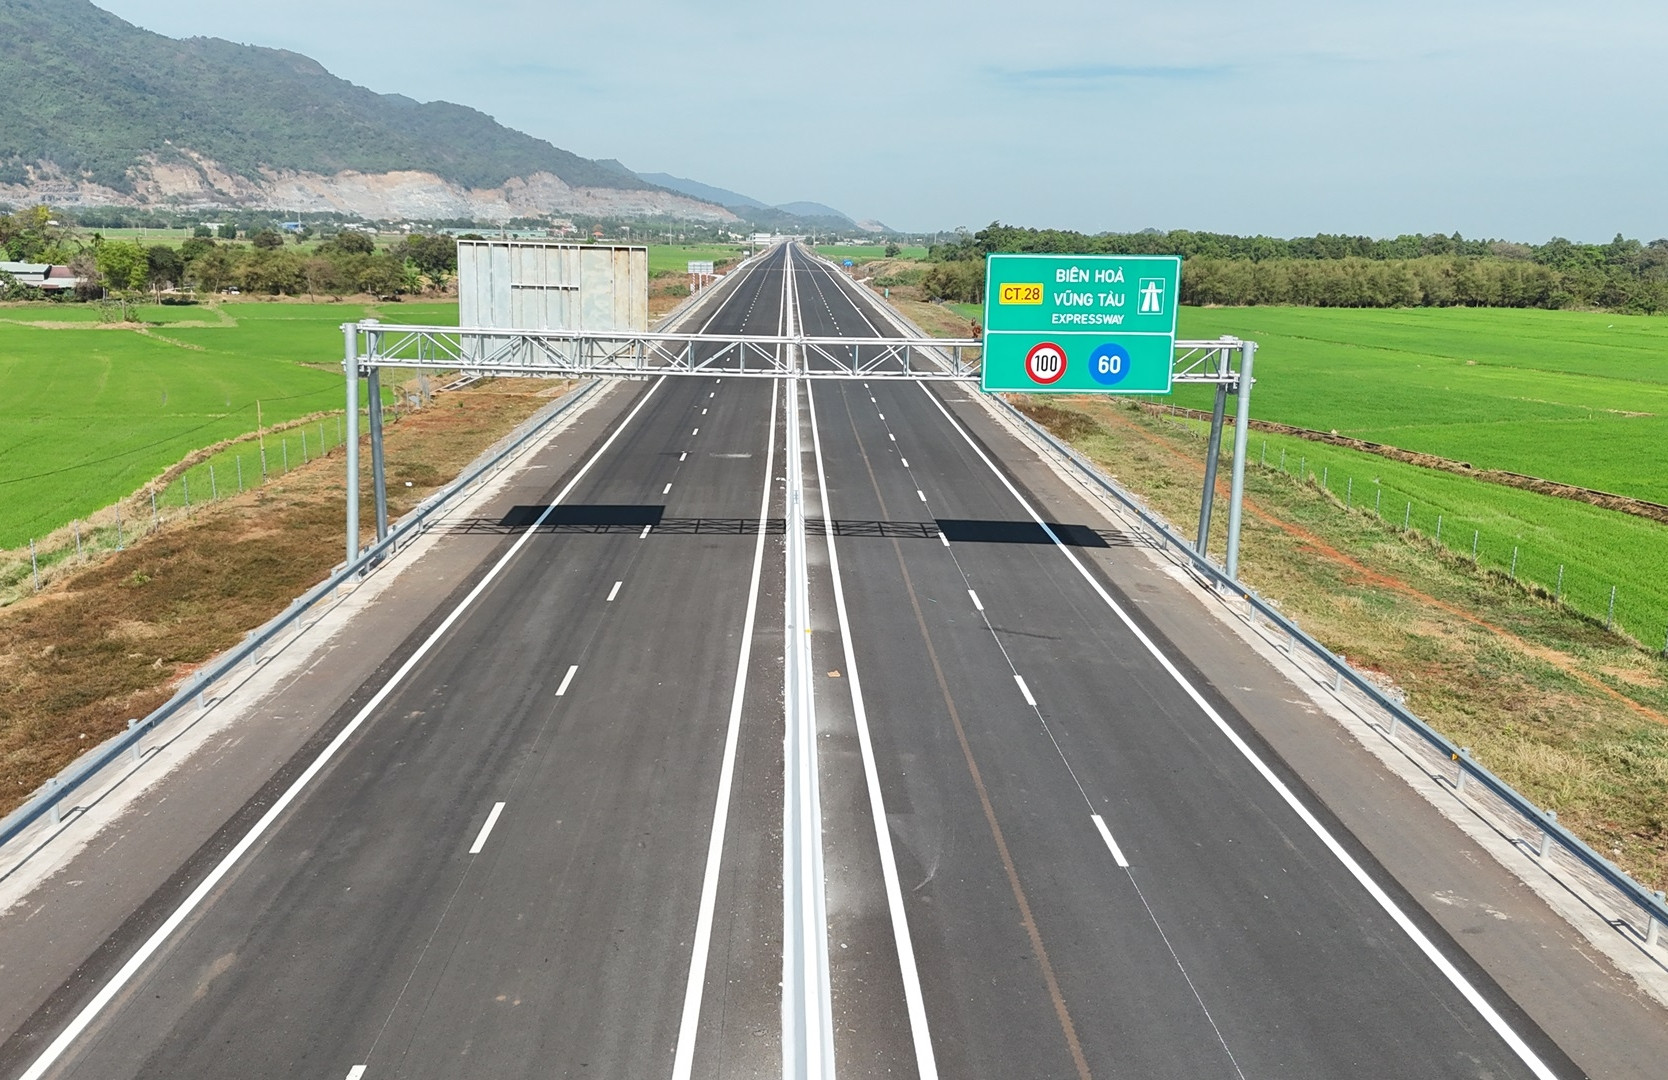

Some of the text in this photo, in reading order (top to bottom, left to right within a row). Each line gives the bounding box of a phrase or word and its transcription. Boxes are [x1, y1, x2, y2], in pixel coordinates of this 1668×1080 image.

[1056, 266, 1124, 283] BIÊN HOÀ
[1005, 288, 1039, 300] CT.28
[1054, 290, 1125, 306] VŨNG TÀU
[1052, 314, 1124, 324] EXPRESSWAY
[1035, 355, 1057, 372] 100
[1098, 356, 1121, 373] 60
